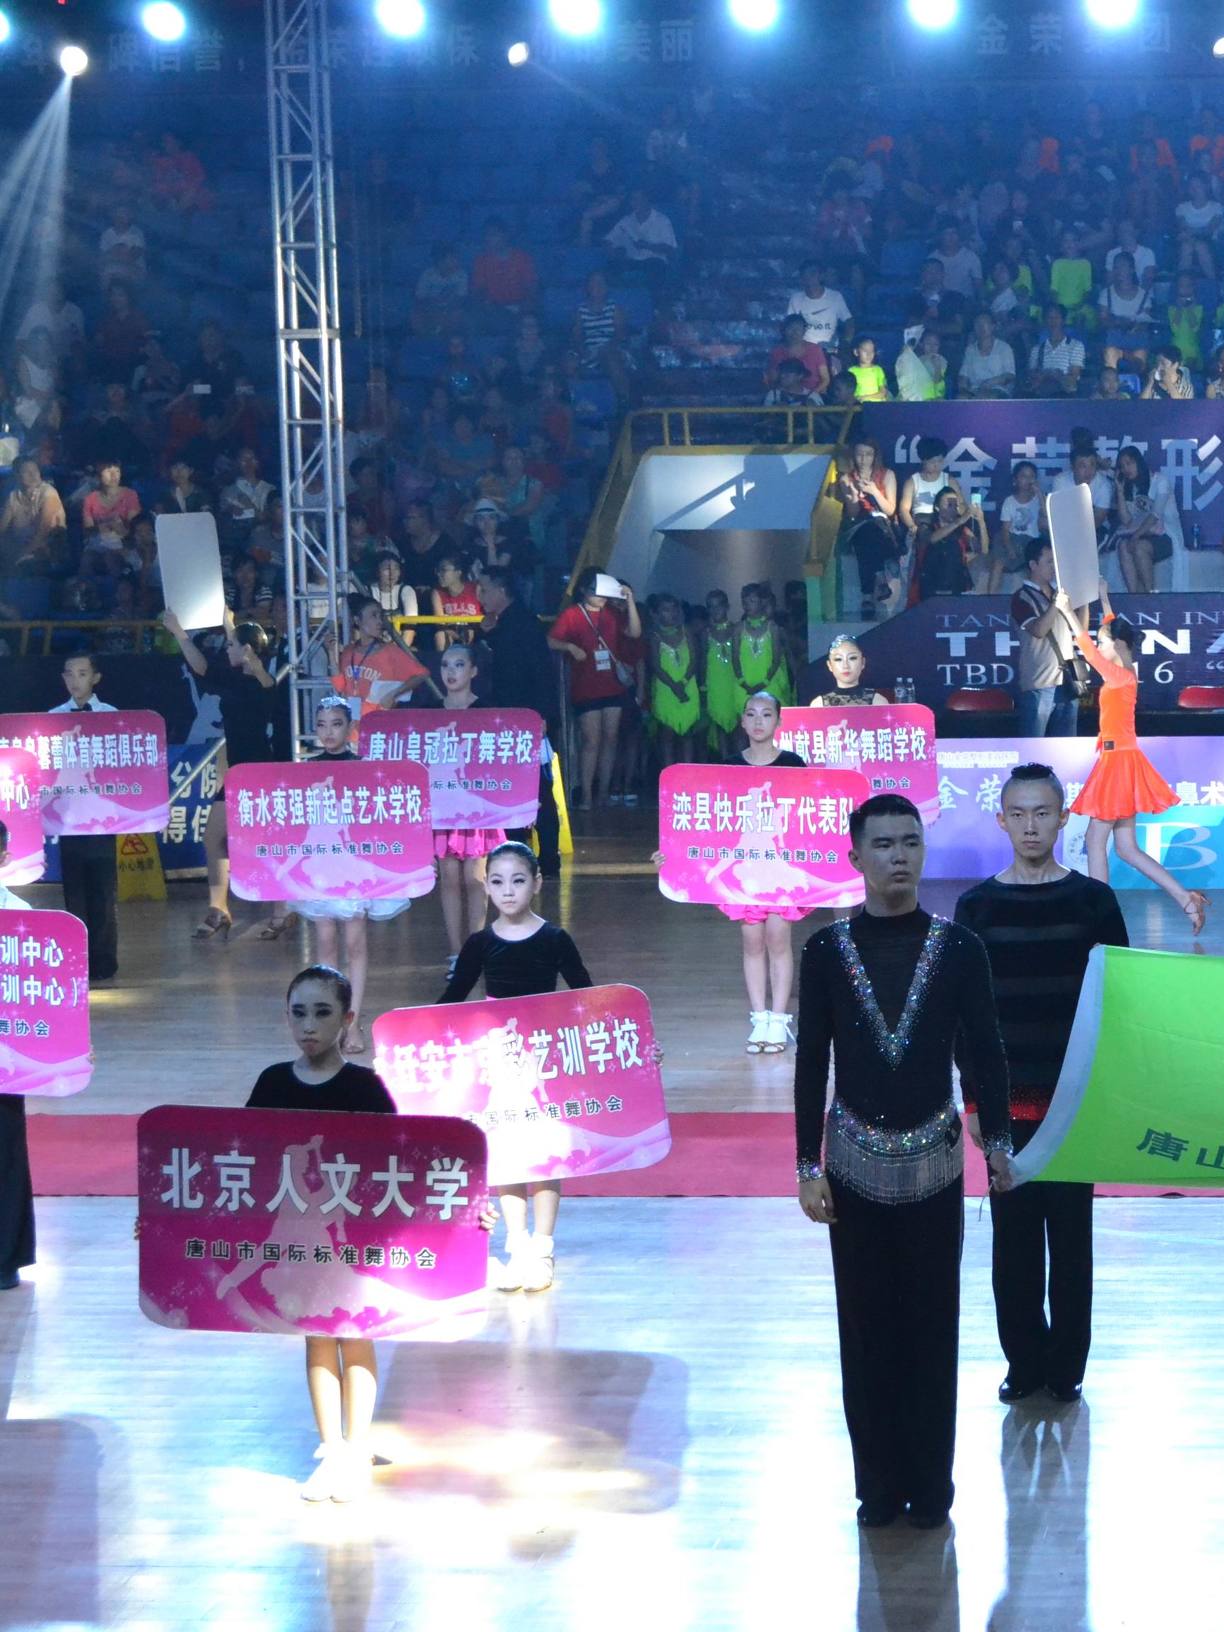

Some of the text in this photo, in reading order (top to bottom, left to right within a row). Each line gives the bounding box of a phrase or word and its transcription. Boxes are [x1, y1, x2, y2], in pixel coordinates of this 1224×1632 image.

[369, 730, 534, 765] 唐山皇冠拉丁舞学校
[773, 727, 928, 765] 州献县新华舞蹈学校
[237, 785, 422, 828] 衡水枣强新起点艺术学校
[256, 842, 404, 857] 唐山市国际标准舞协会
[688, 846, 838, 863] 唐山市国际标准舞协会
[161, 1148, 469, 1221] 北京人文大学
[186, 1238, 436, 1267] 唐山市国际标准舞协会
